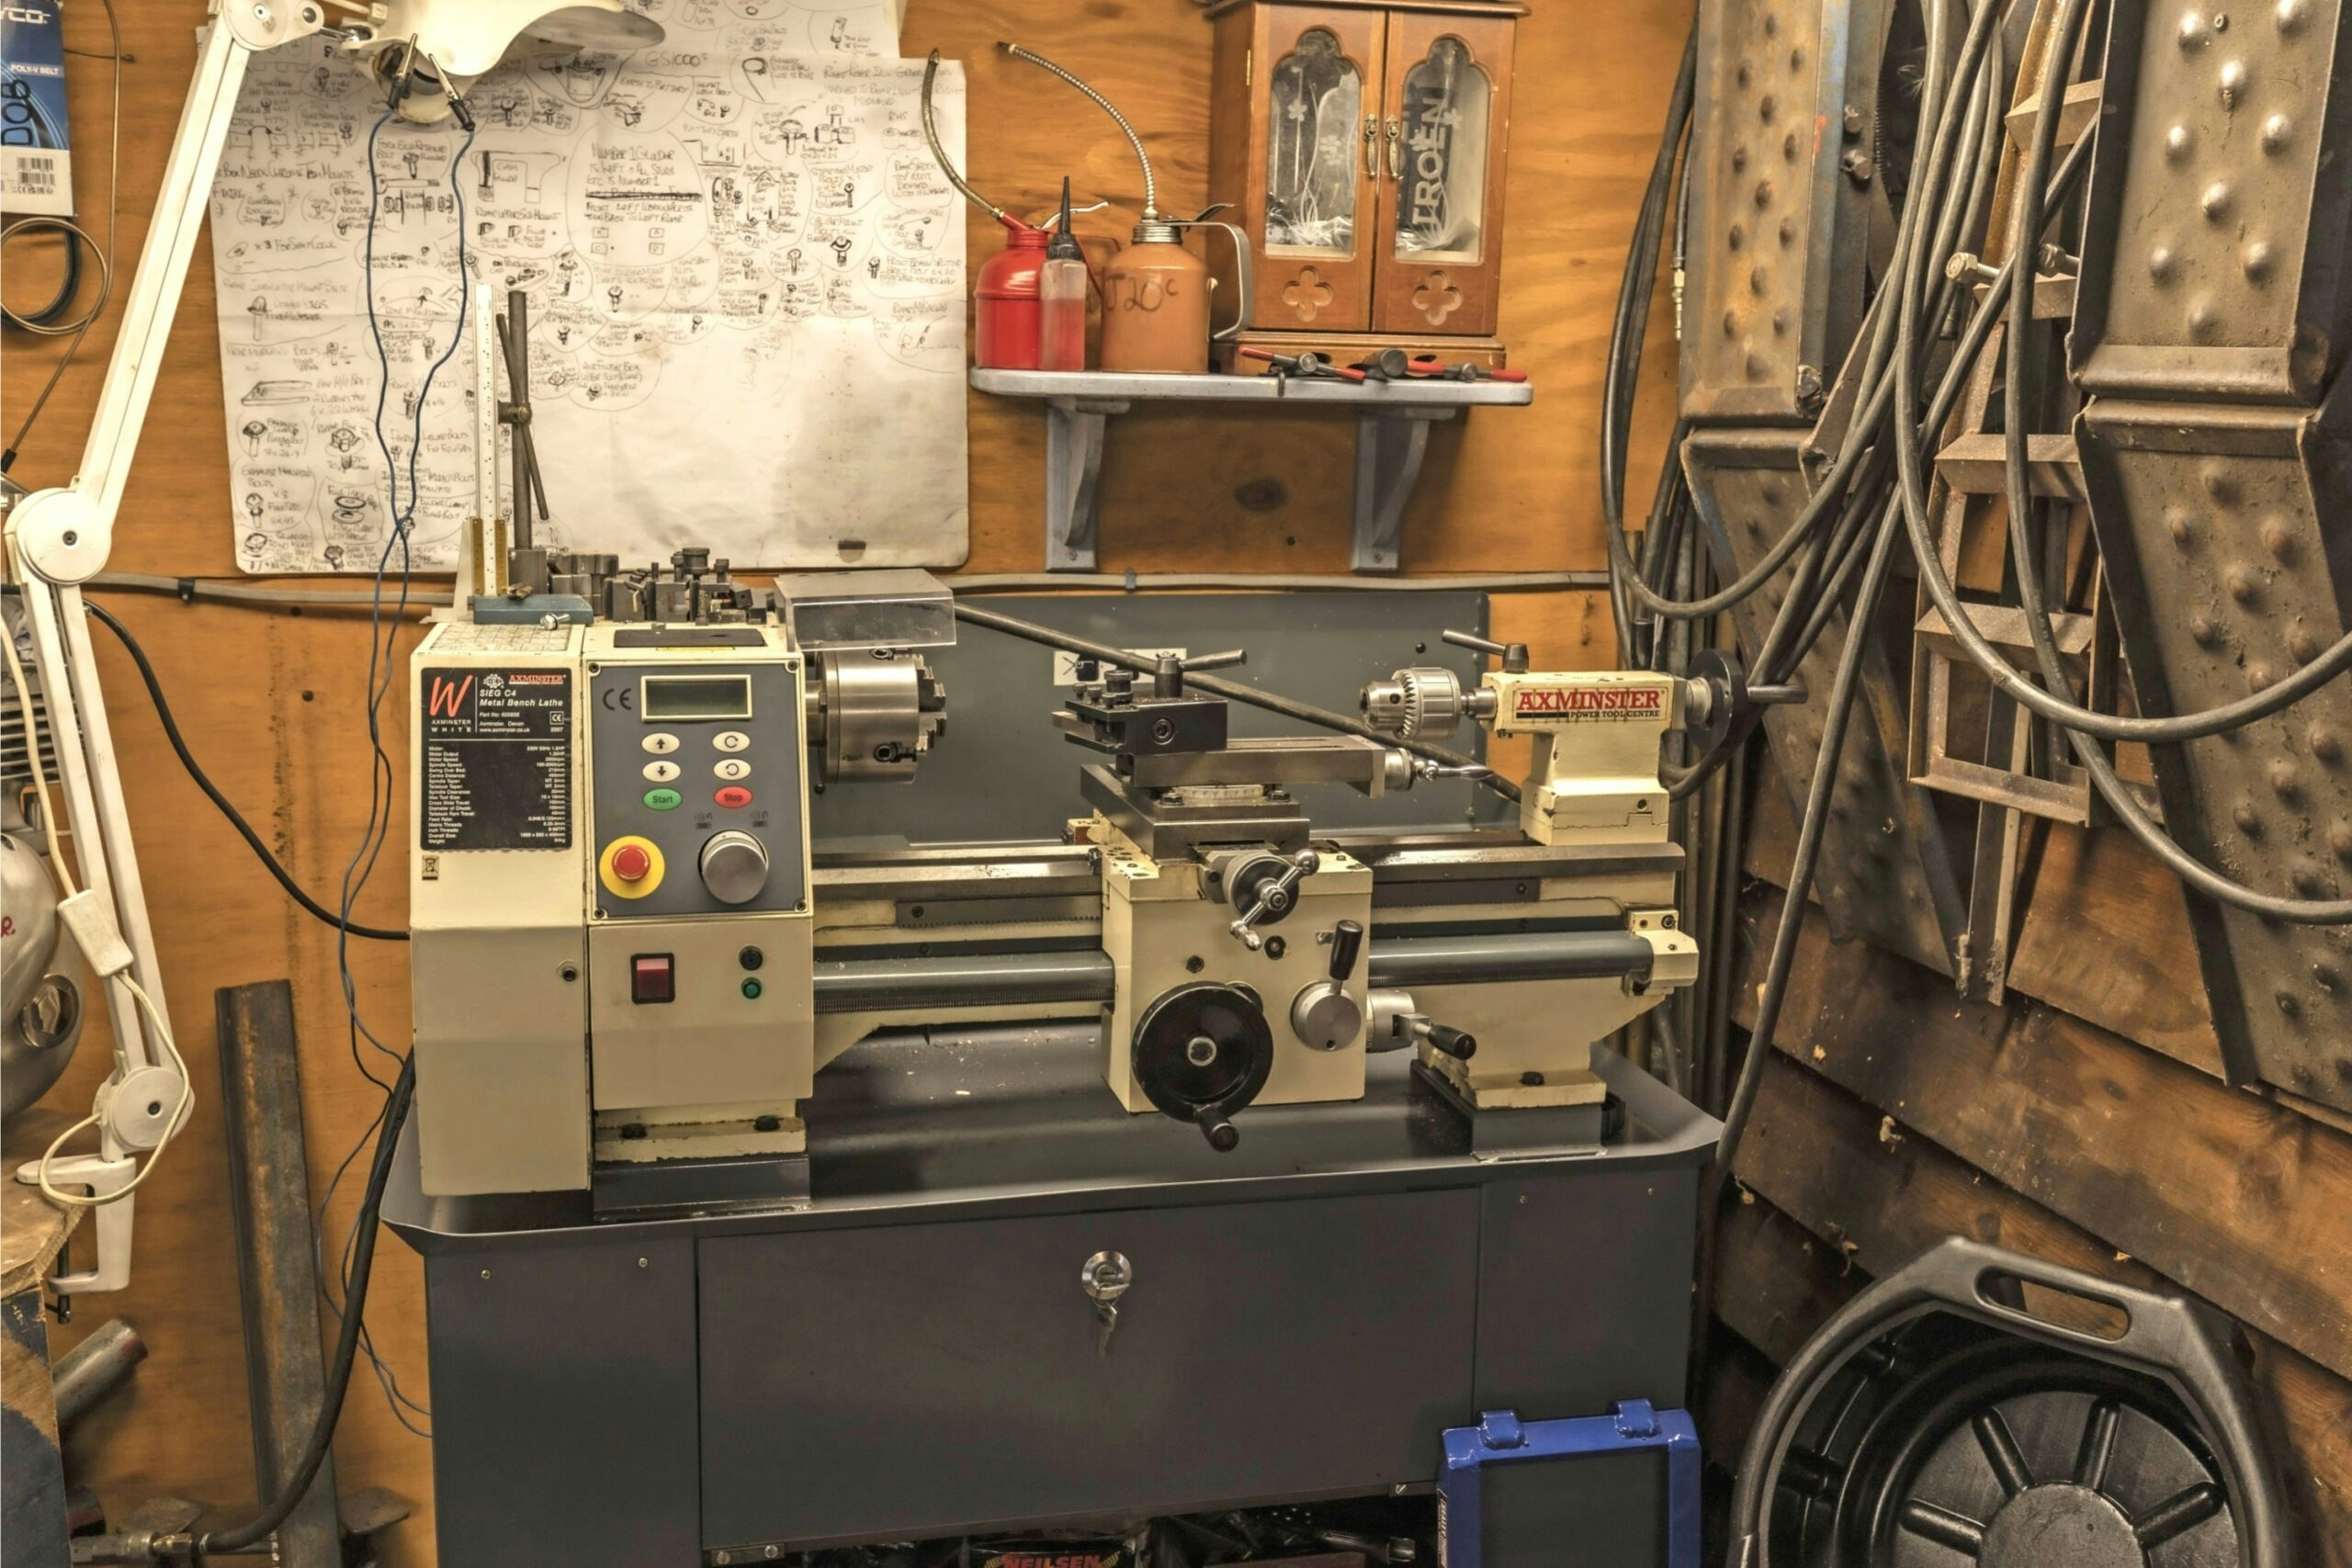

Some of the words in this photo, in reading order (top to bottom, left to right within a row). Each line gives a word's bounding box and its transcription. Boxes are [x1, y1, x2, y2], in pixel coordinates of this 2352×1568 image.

[11, 64, 39, 73] POLY-V
[40, 65, 59, 75] BELT
[508, 674, 563, 683] AXMINSTER
[480, 689, 501, 697] SIEG
[480, 698, 504, 707] Metal
[507, 699, 536, 707] Bench
[538, 699, 563, 707] Lathe
[1517, 690, 1661, 711] AXMINSTER
[652, 795, 673, 804] Start
[724, 793, 743, 802] Stop
